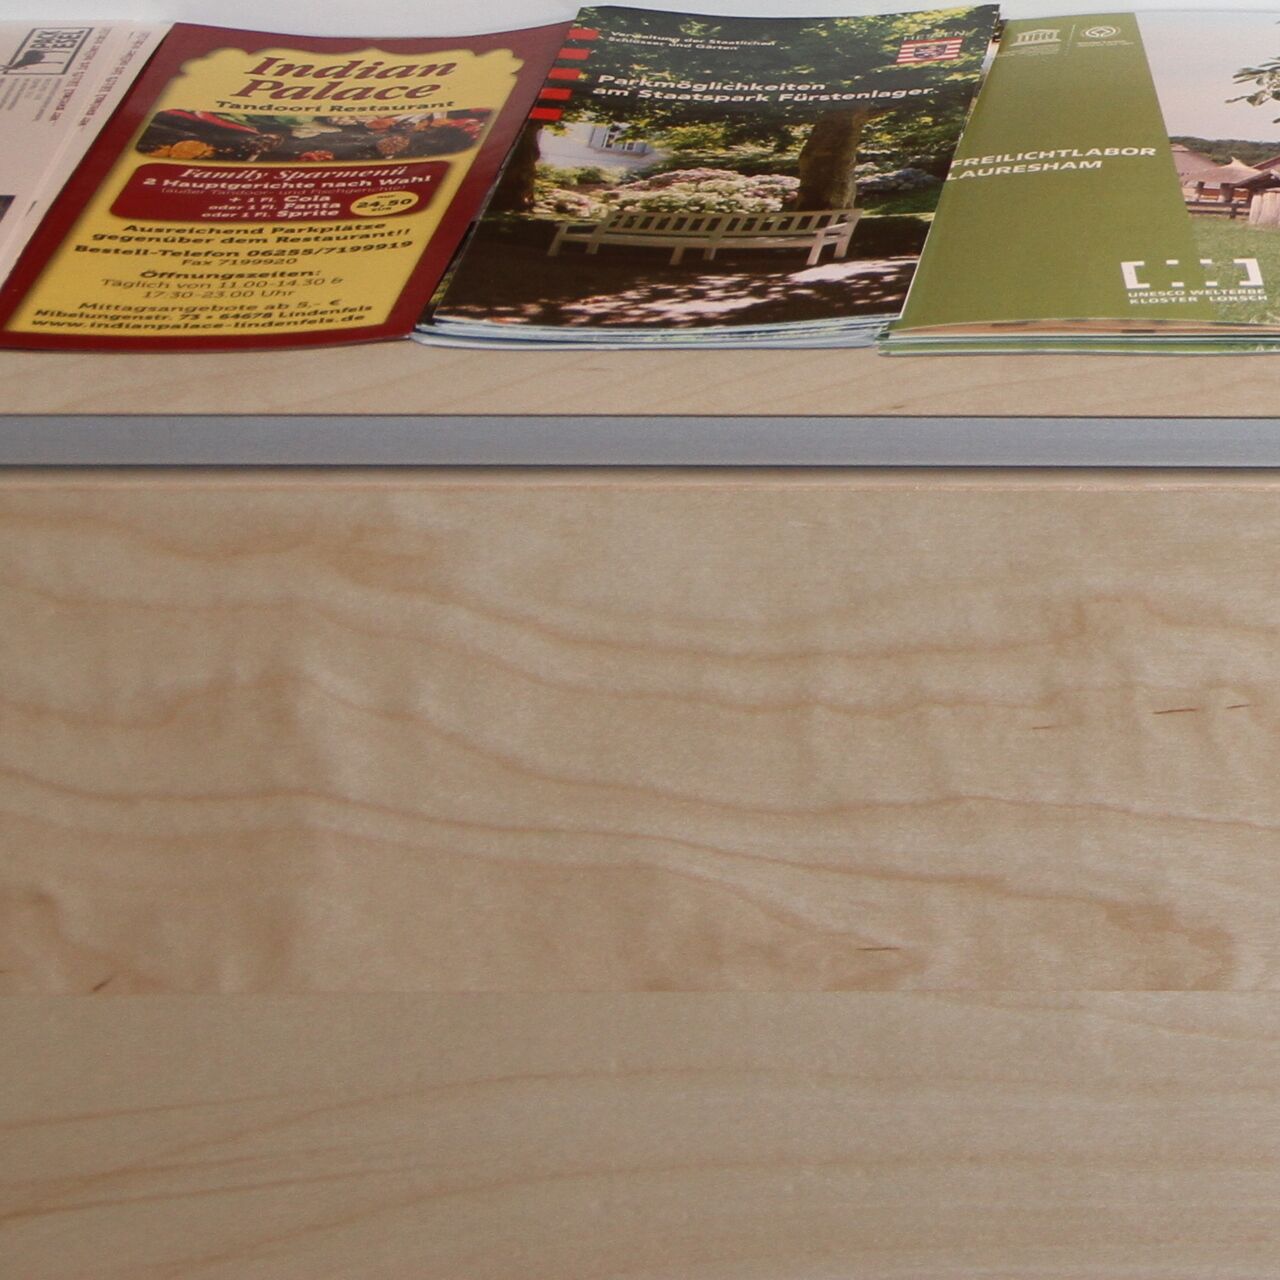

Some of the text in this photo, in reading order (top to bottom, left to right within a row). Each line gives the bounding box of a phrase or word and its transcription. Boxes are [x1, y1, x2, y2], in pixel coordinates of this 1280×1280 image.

[30, 30, 61, 50] PACK
[52, 30, 84, 50] ESEL
[610, 31, 681, 42] Verwaltung
[695, 43, 739, 51] Gärten
[244, 56, 458, 79] Indian
[598, 74, 826, 92] Parkmöglichkeiten
[229, 79, 442, 103] Palace
[592, 86, 630, 99] am
[638, 88, 770, 104] Staatspark
[216, 100, 455, 112] Tandoori Restaurant
[950, 147, 1157, 168] FREILICHTLABOR
[180, 166, 408, 181] Family Sparmenü
[945, 160, 1103, 181] LAURESHAM
[162, 179, 315, 190] Hauptgerichte
[321, 180, 372, 188] nach
[379, 176, 431, 186] Wahl
[284, 195, 331, 203] Cola
[284, 202, 341, 210] Fanta
[276, 210, 341, 219] Sprite
[122, 222, 386, 234] Ausreichend Parkplätze
[92, 233, 268, 244] gegenüber dem
[74, 245, 240, 257] Bestell-Telefon
[139, 270, 322, 281] Öffnungszeiten:
[101, 279, 170, 290] Täglich
[259, 289, 296, 298] Uhr
[1127, 287, 1265, 298] UNESCO WELTERBE
[1129, 294, 1267, 305] KLOSTER LORSCH
[35, 304, 373, 322] Nibelungenstr. Lindenfels
[78, 302, 289, 312] Mittagsangebote ab
